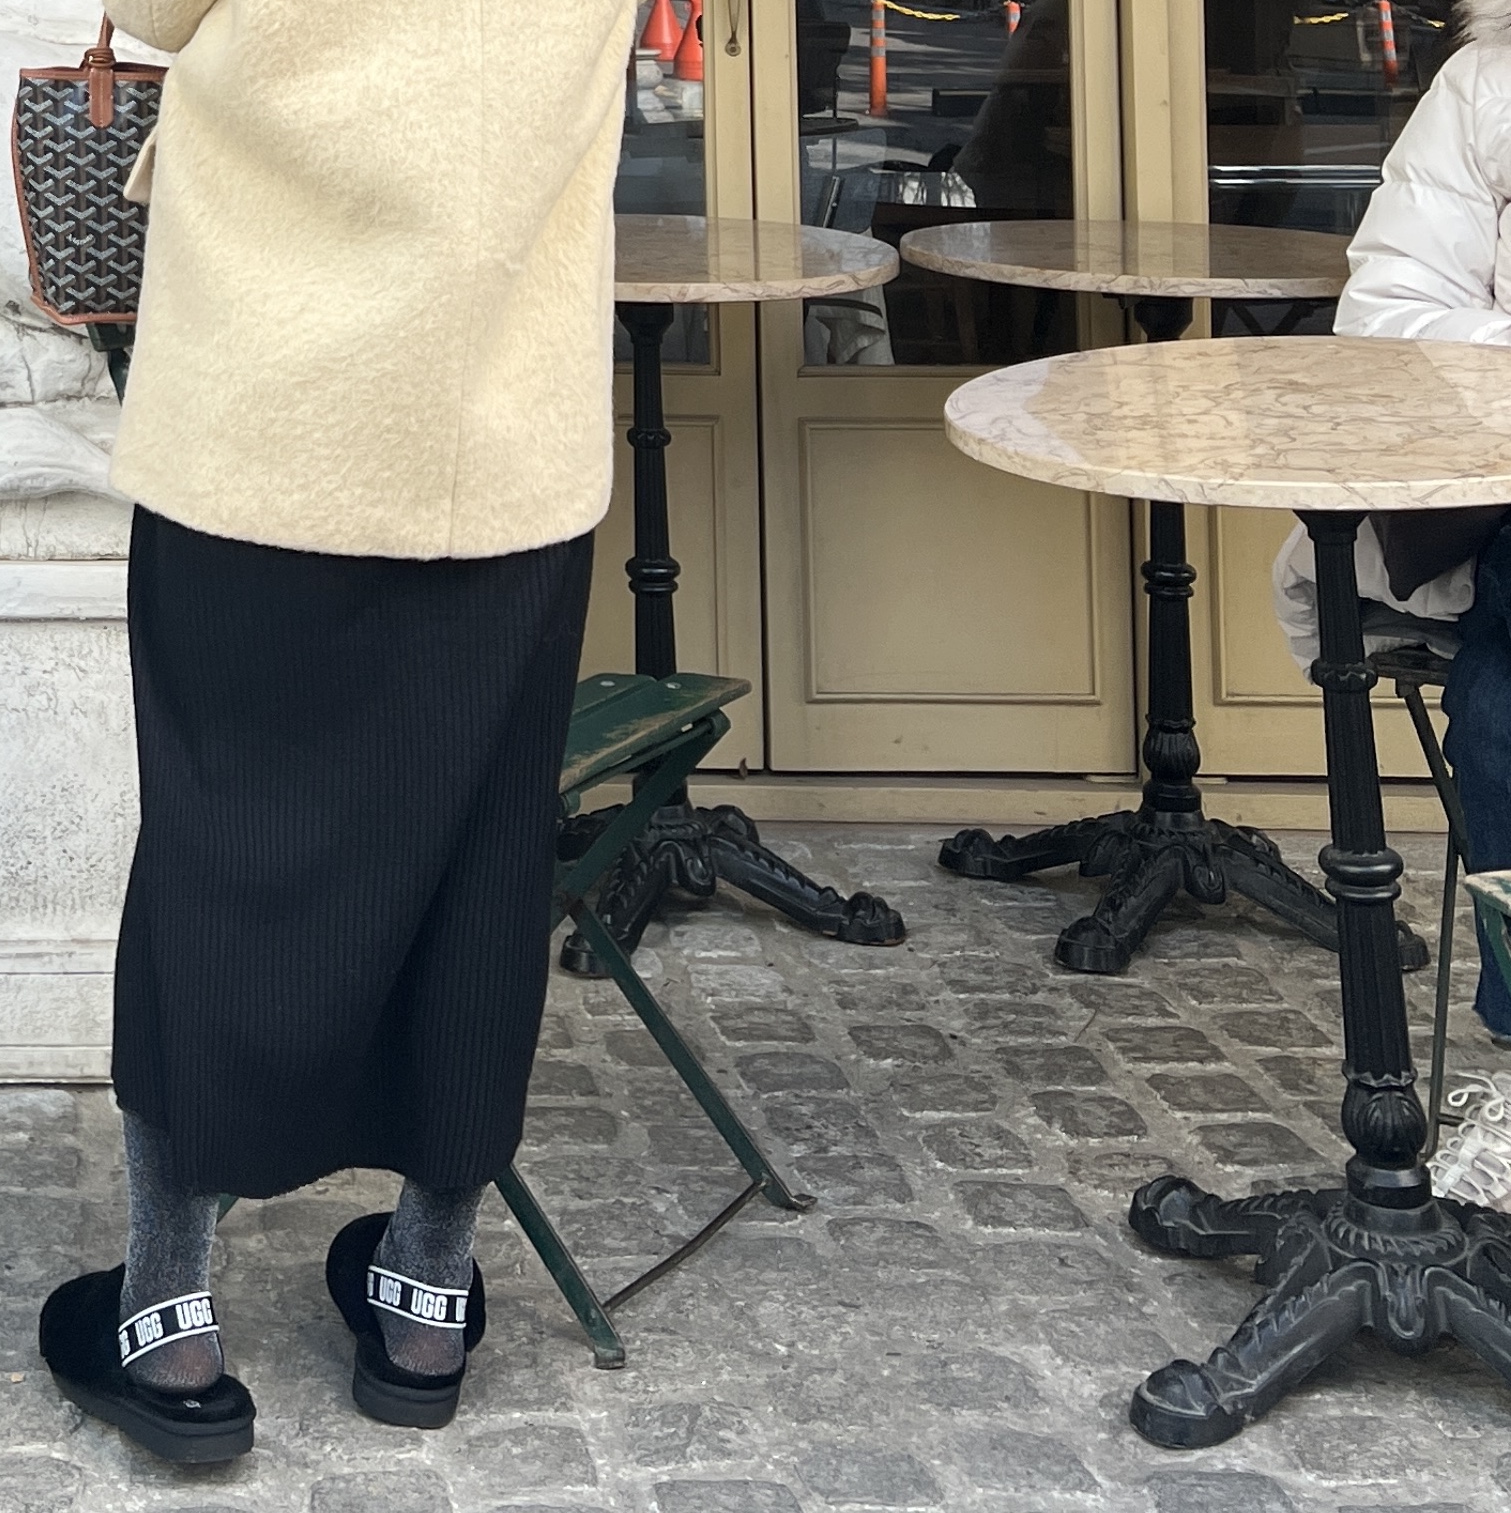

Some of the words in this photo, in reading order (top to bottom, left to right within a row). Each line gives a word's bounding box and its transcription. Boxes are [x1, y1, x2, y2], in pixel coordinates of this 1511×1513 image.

[379, 1275, 402, 1307] UGG
[410, 1288, 448, 1321] UGG
[134, 1312, 164, 1347] UGG
[175, 1298, 214, 1330] UGG
